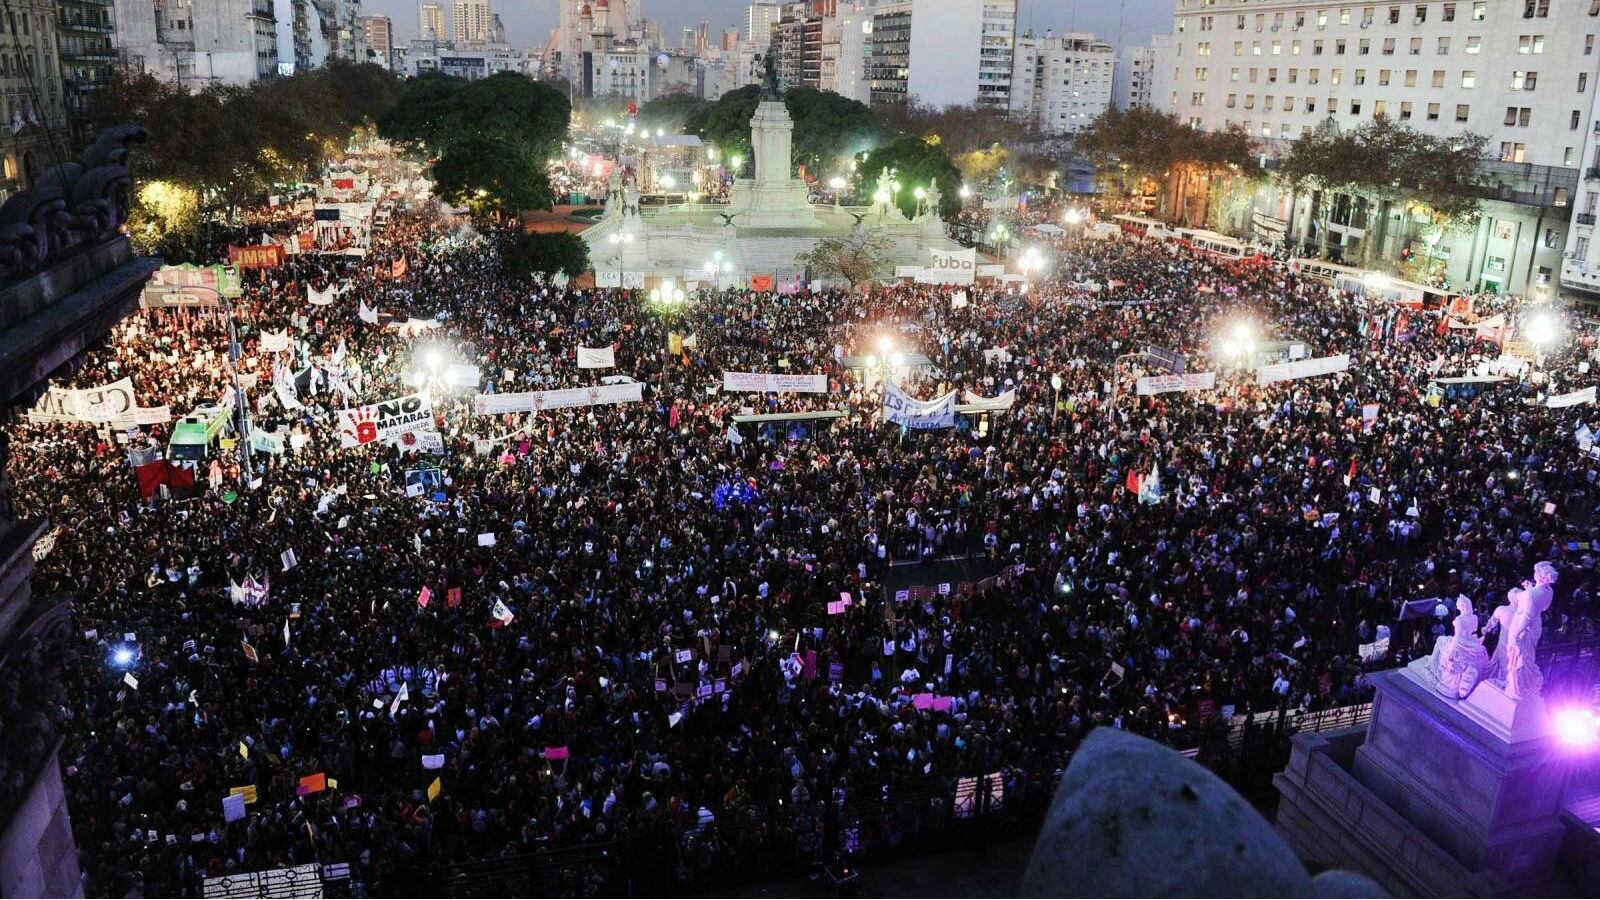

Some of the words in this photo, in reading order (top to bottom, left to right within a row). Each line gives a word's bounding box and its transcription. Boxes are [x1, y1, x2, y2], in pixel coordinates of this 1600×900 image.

[932, 254, 972, 269] fuba
[378, 397, 421, 420] NO
[376, 410, 430, 430] MATARAS
